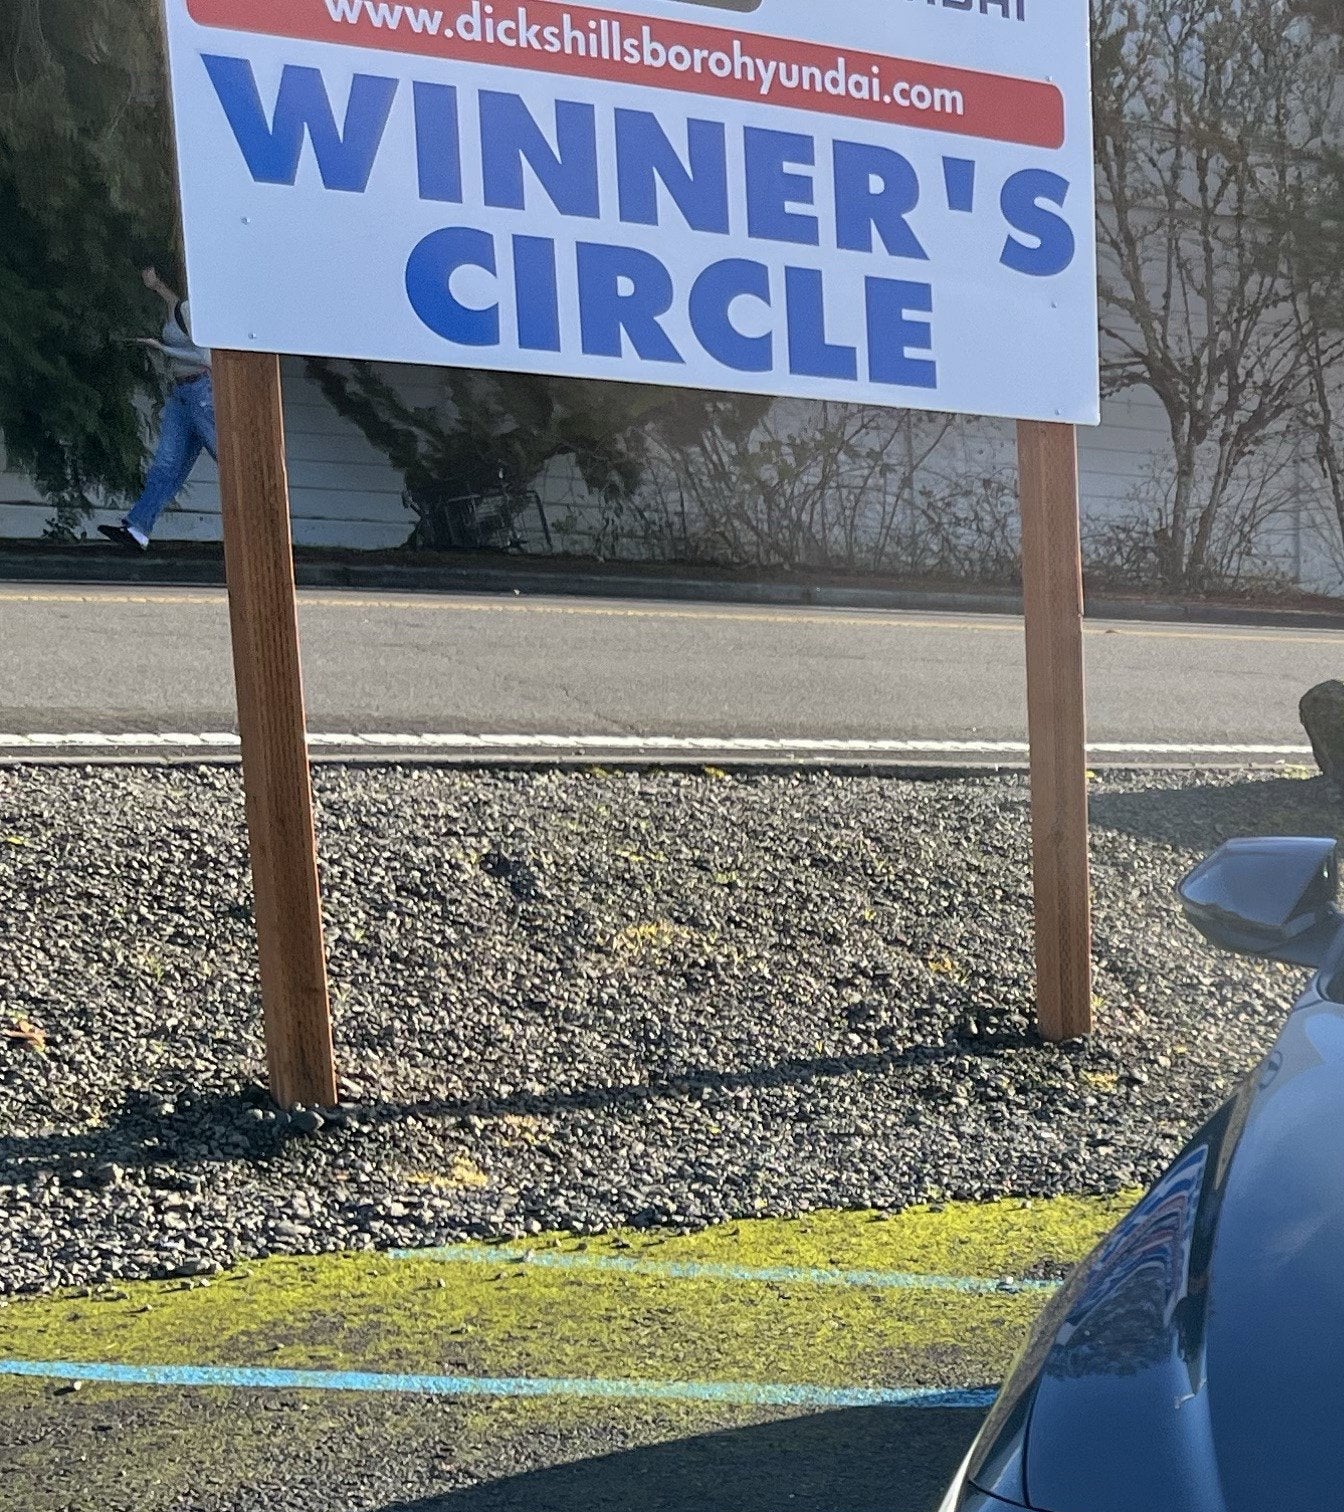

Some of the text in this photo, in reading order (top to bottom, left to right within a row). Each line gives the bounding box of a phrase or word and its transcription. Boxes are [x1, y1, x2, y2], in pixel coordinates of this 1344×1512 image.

[324, 0, 964, 116] www.dickshillsborohyundai.com
[201, 53, 1075, 277] WINNER'S
[406, 226, 937, 389] CIRCLE
